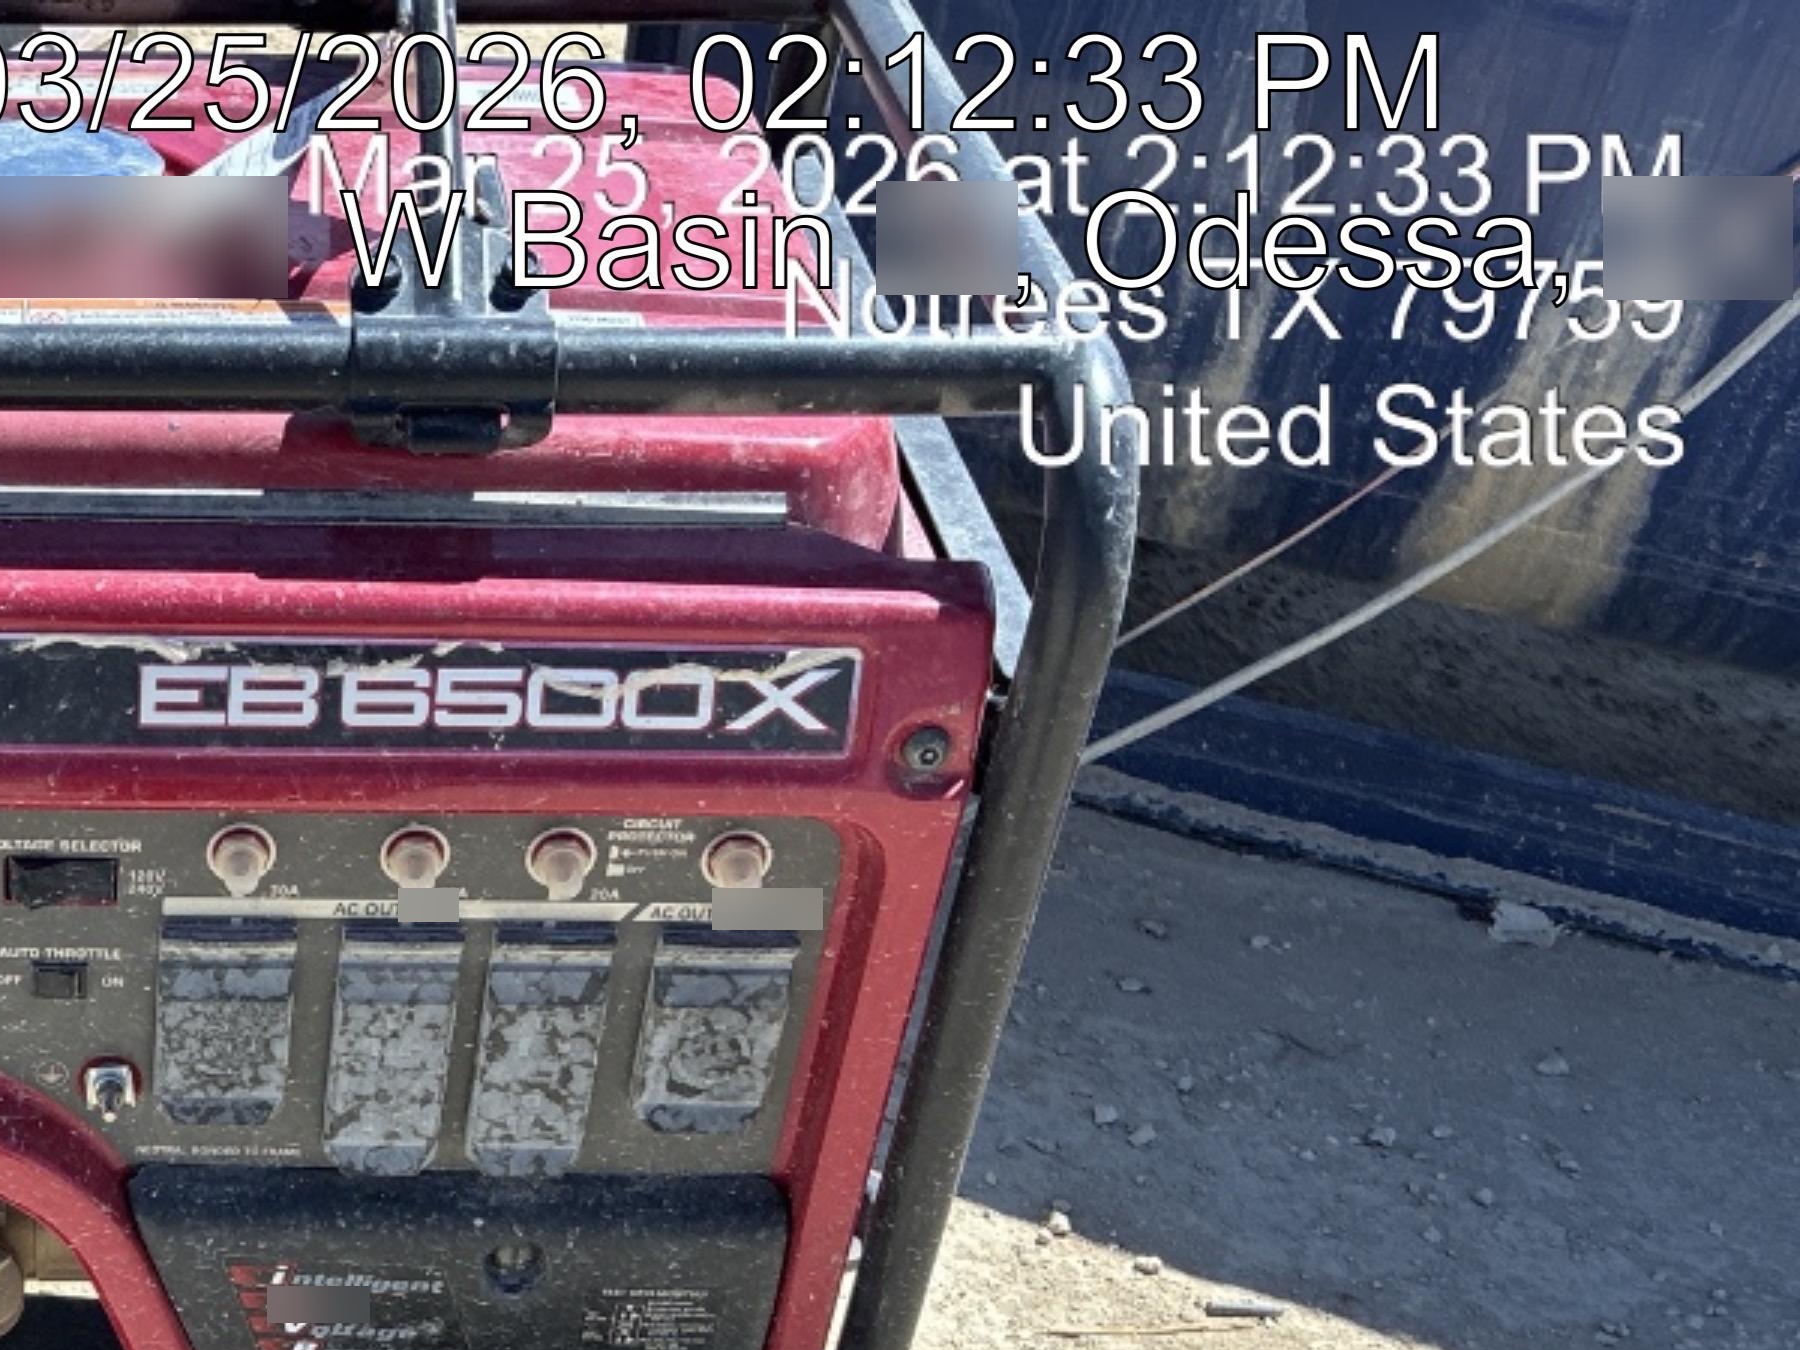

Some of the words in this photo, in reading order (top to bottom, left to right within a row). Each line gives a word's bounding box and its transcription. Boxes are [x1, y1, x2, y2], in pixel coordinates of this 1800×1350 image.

[59, 839, 142, 853] SELECTOR
[332, 902, 359, 917] AC
[650, 907, 675, 921] AC
[45, 948, 121, 961] THROTTLE
[101, 976, 124, 988] ON
